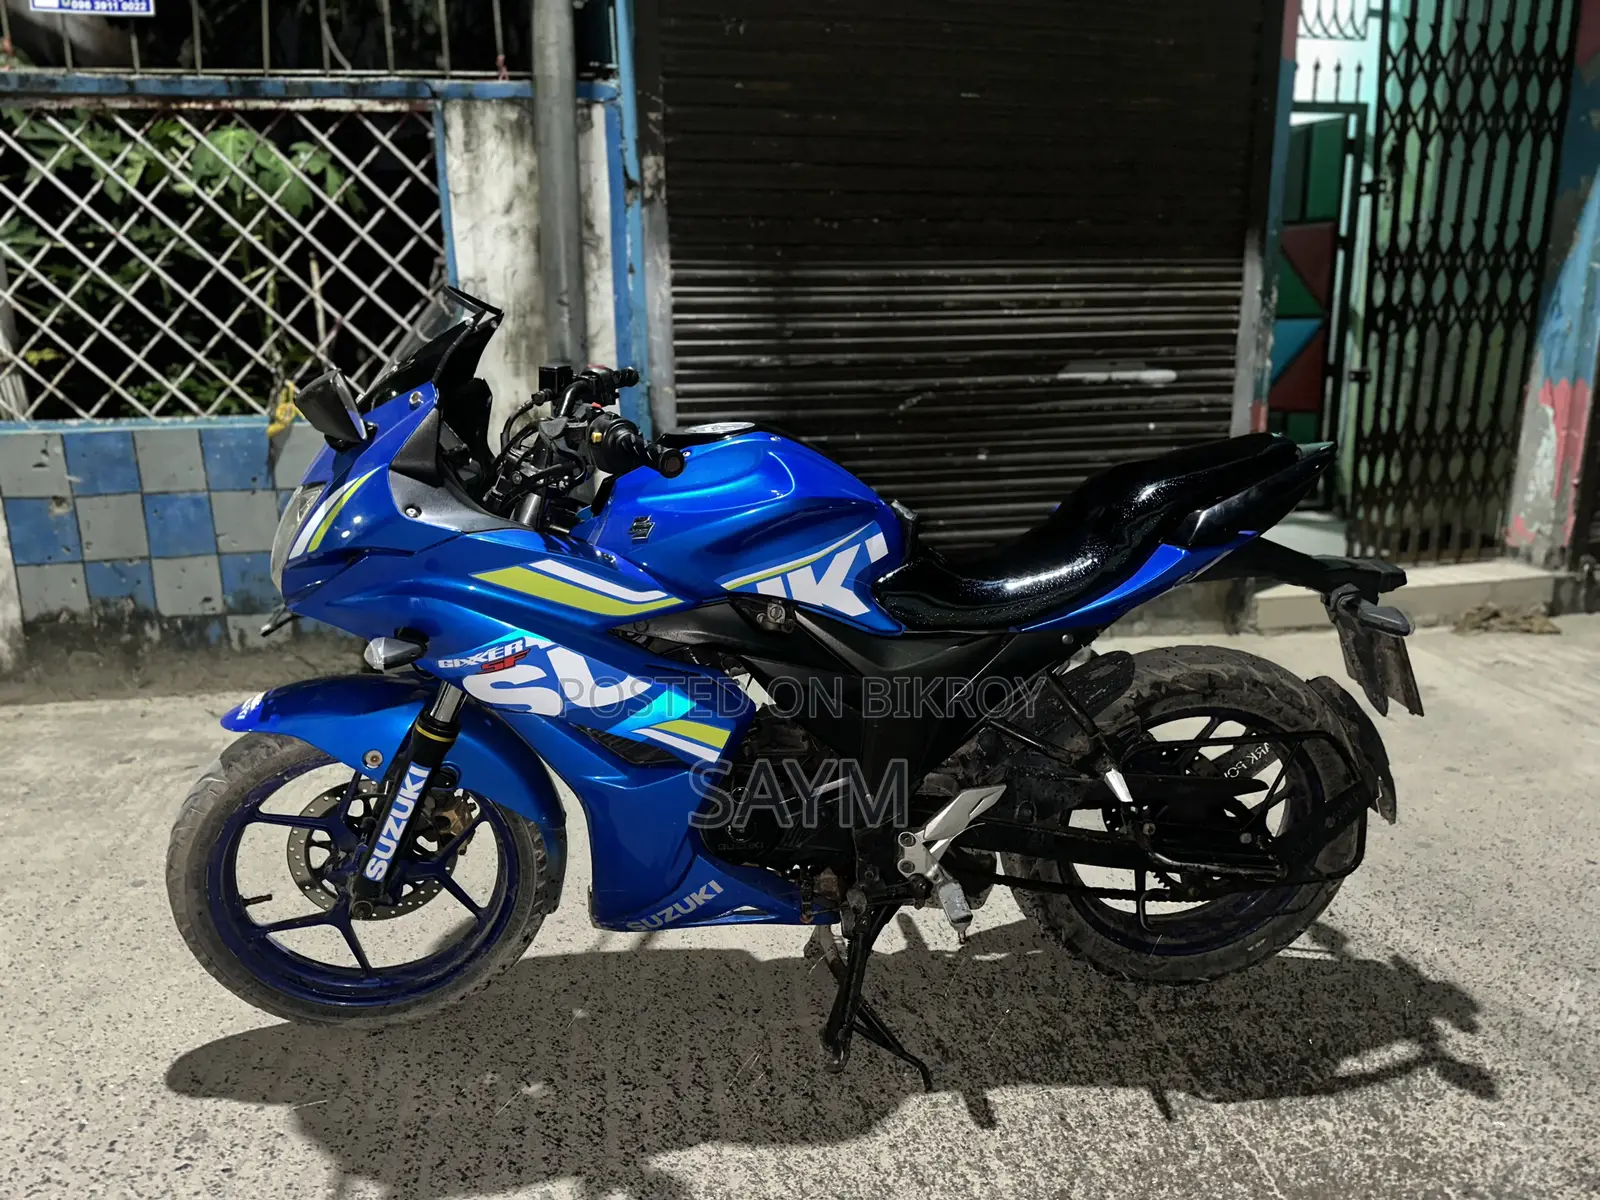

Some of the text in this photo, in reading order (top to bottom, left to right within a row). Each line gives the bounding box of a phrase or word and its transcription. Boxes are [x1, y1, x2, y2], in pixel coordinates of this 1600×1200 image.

[438, 639, 524, 668] GIXXER
[476, 648, 531, 675] SF
[365, 765, 430, 880] SUZUKI
[626, 880, 724, 931] SUZUKI
